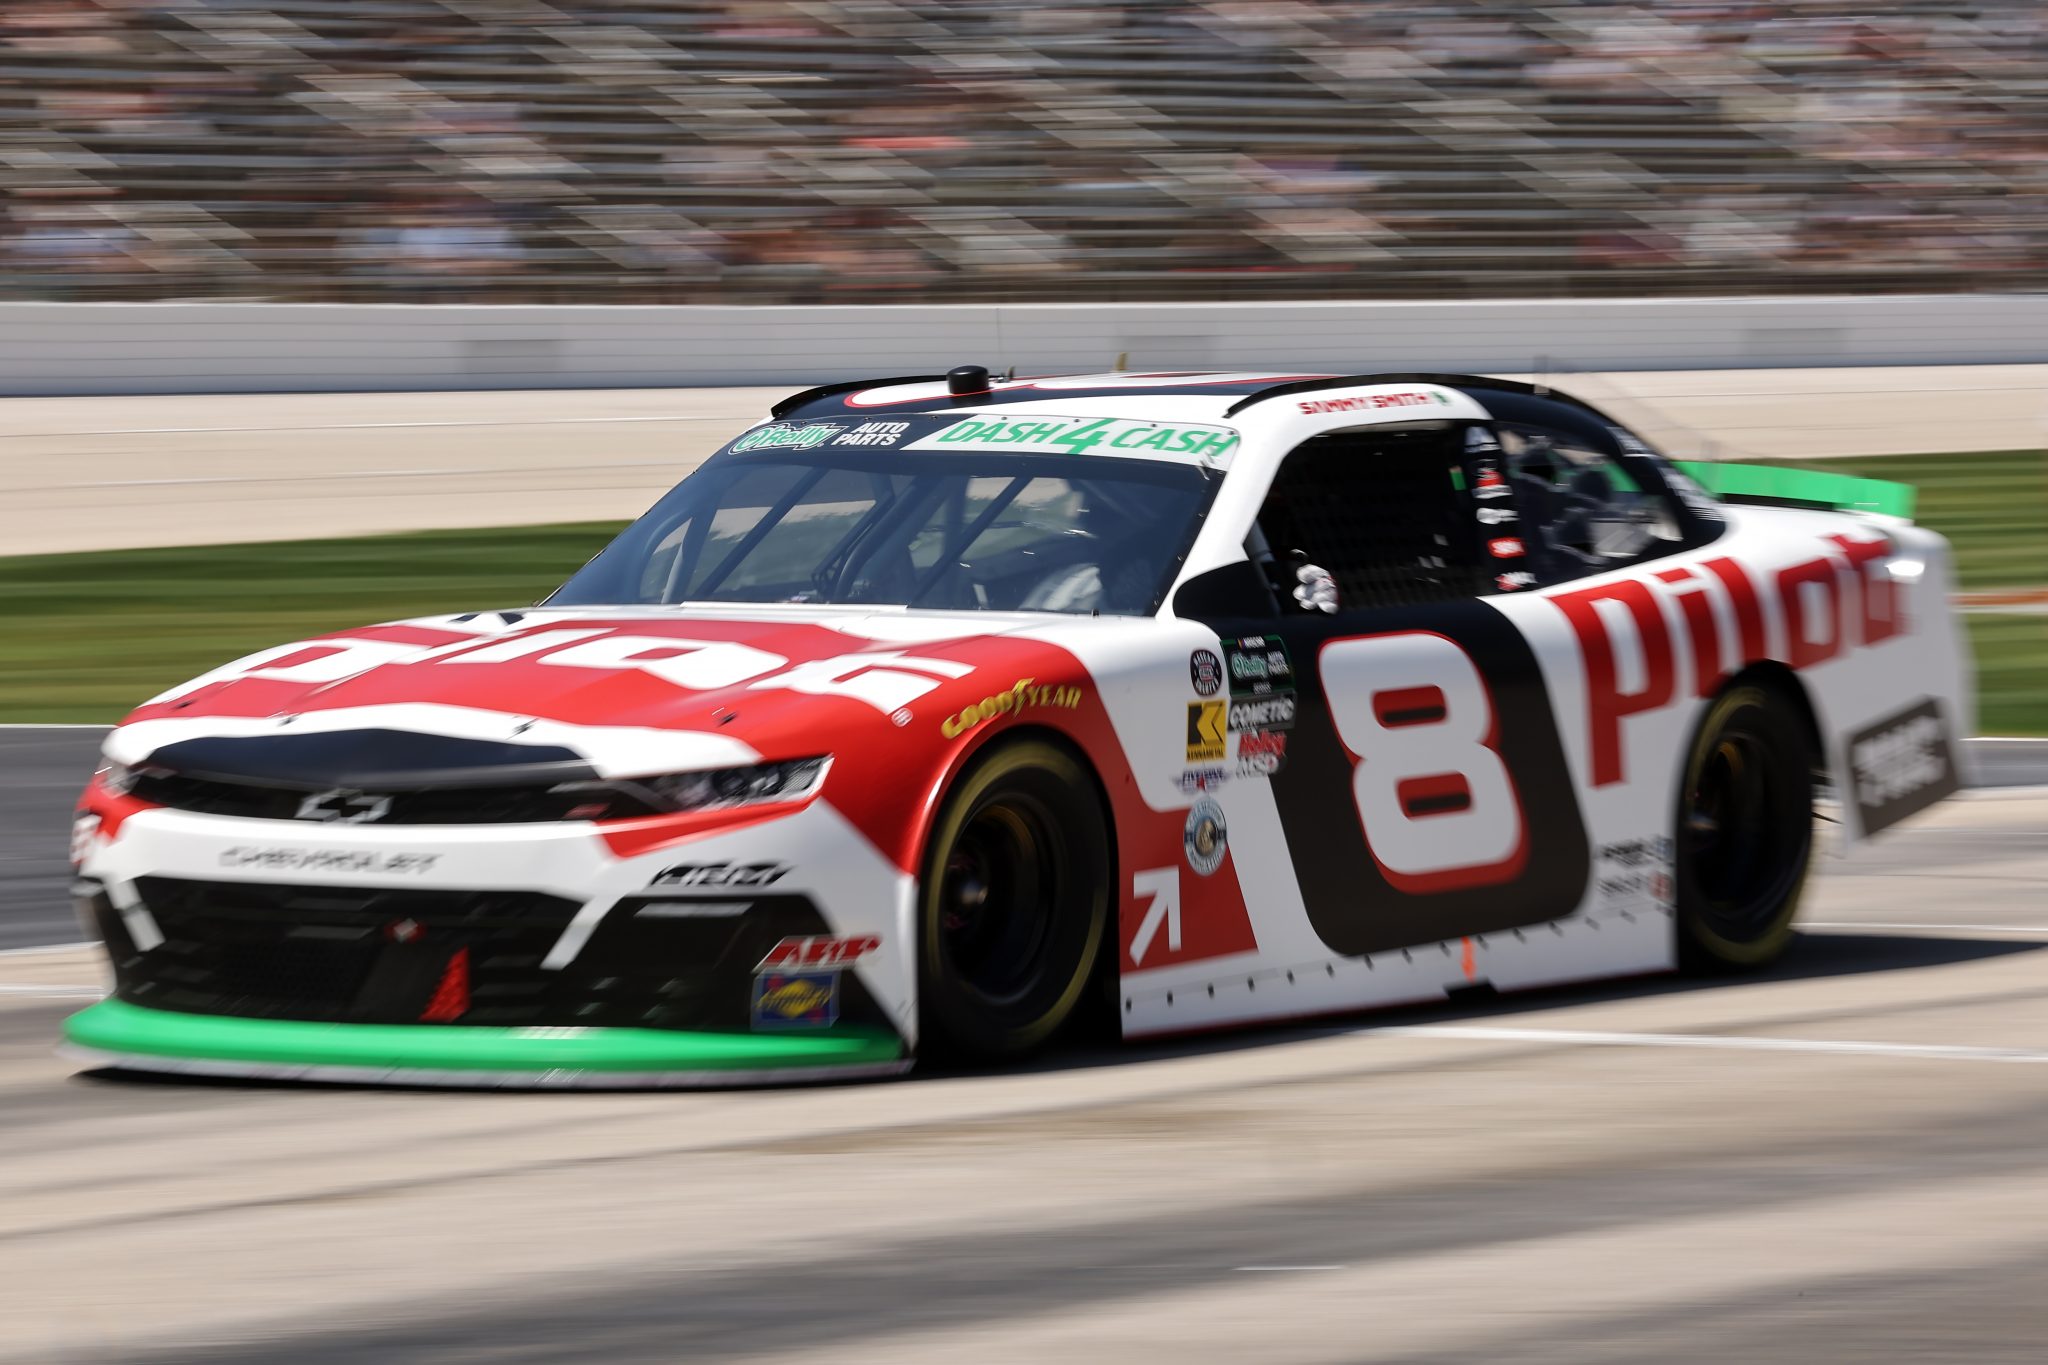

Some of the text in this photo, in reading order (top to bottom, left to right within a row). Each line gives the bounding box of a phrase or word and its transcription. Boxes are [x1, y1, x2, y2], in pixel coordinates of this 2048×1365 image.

[1297, 391, 1435, 415] SAMMY SMITH
[732, 422, 910, 452] O'Reilly AUTO
[830, 433, 901, 446] PARTS
[936, 418, 1240, 457] DASH 4 CASH
[1545, 533, 1914, 789] pilot
[941, 677, 1082, 740] GOODYEAR
[1316, 629, 1532, 895] 8
